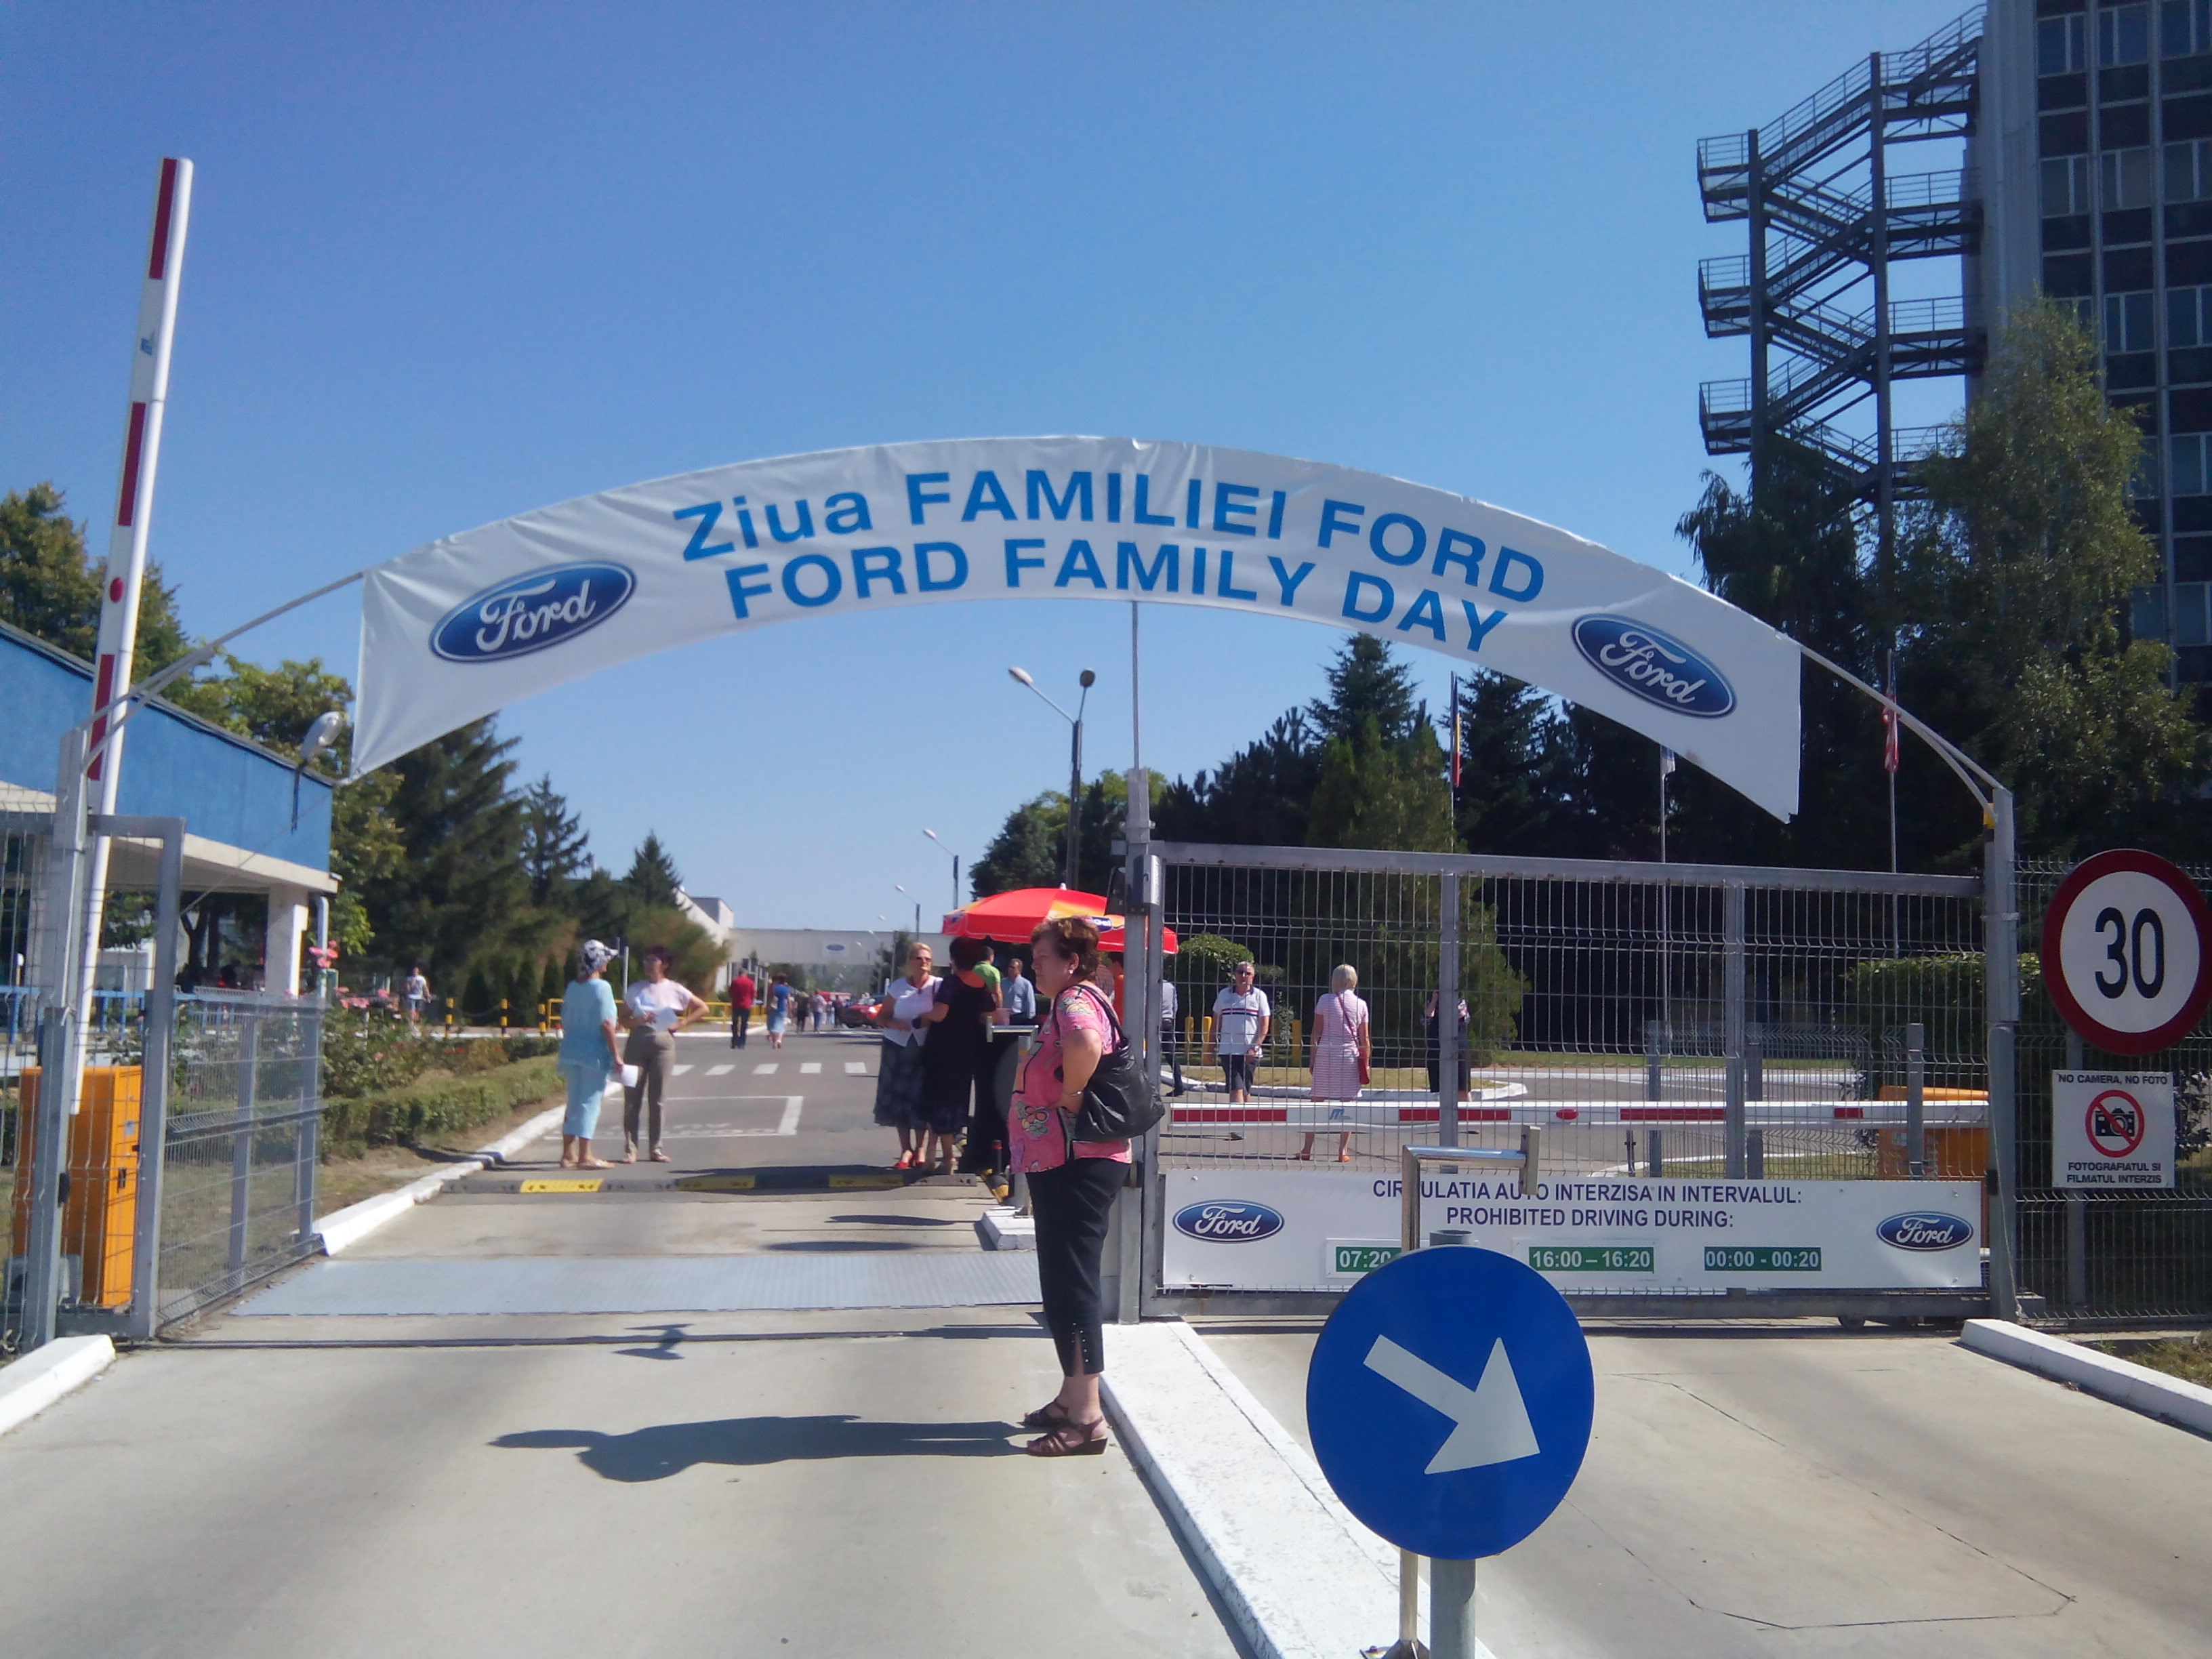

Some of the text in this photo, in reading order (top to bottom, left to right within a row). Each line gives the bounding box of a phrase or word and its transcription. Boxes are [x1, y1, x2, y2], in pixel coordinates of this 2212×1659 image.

[672, 469, 1546, 604] Ziua FAMILIEI FORD
[724, 539, 1509, 653] FORD FAMILY DAY
[476, 579, 596, 653] Ford
[1599, 630, 1707, 704] Ford
[2095, 906, 2165, 1000] 30
[2058, 1074, 2168, 1084] NO CAMERA, NO FOTO
[2067, 1174, 2162, 1184] FILMATUL INTERZIS
[2068, 1162, 2162, 1172] FOTOGRAFIATUL SI
[1373, 1180, 1490, 1200] CIRULATIA
[1555, 1184, 1652, 1202] INTERZISA
[1658, 1185, 1675, 1202] IN
[1682, 1186, 1801, 1204] INTERVALUL:
[1194, 1205, 1262, 1235] Ford
[1447, 1207, 1734, 1228] PROHIBITED DRIVING DURING:
[1896, 1217, 1954, 1243] Ford
[1533, 1250, 1582, 1267] 16:00
[1602, 1251, 1650, 1268] 16:20
[1706, 1252, 1755, 1267] 00:00
[1771, 1252, 1820, 1267] 00:20
